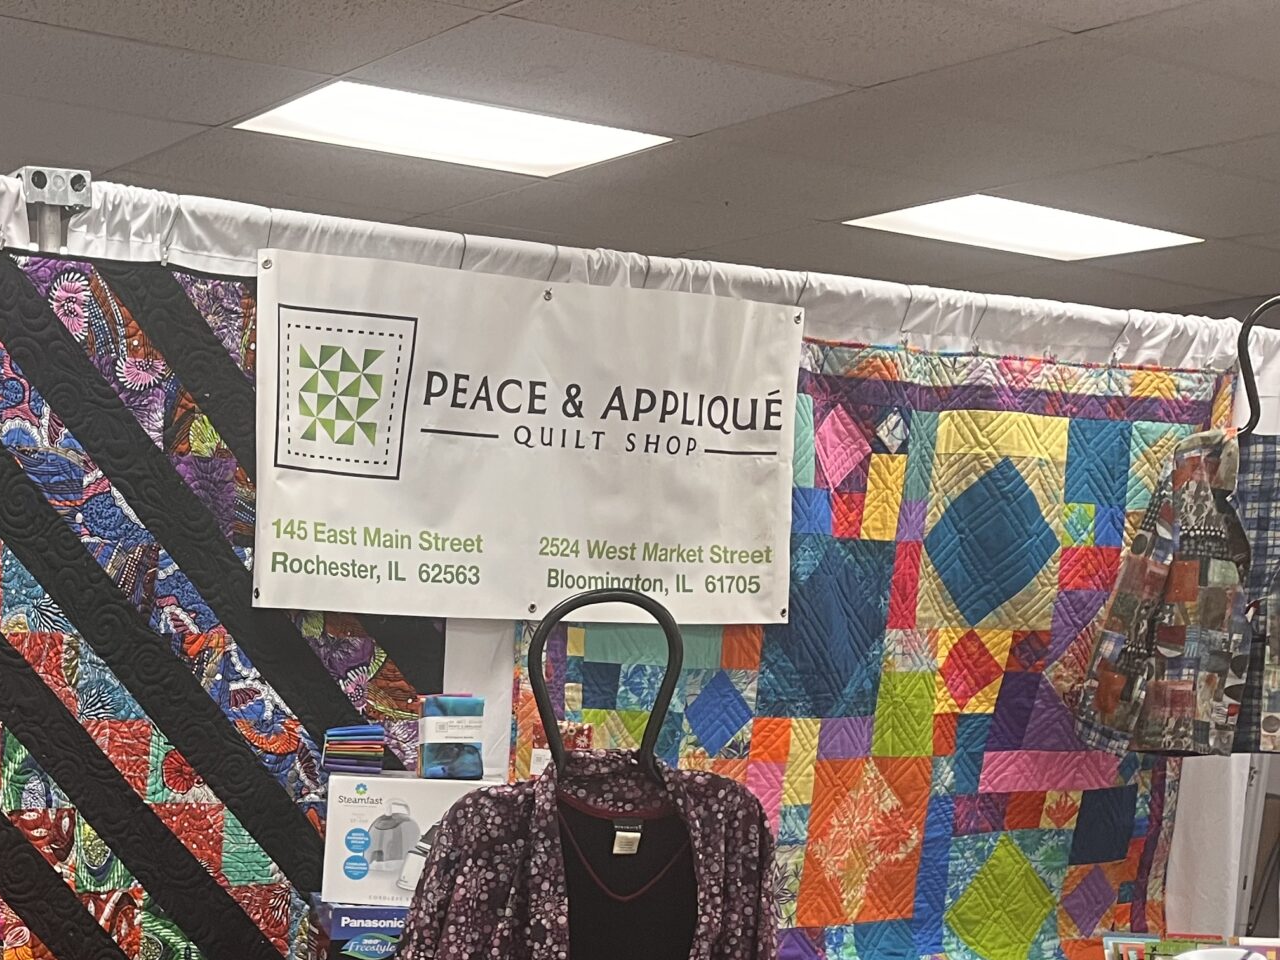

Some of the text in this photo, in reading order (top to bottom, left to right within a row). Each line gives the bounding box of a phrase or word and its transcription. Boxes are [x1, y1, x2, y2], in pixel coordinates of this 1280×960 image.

[422, 370, 783, 435] PEACE & APPLIQUÉ
[513, 425, 697, 456] QUILT SHOP
[271, 518, 484, 553] 145 East Main Street
[538, 536, 773, 564] 2524 West Market Street
[271, 551, 480, 585] Rochester, IL 62563
[546, 568, 761, 596] Bloomington, IL 61705
[338, 795, 383, 805] Steamfast
[340, 916, 405, 928] Panasonic
[348, 941, 397, 954] Freestyle
